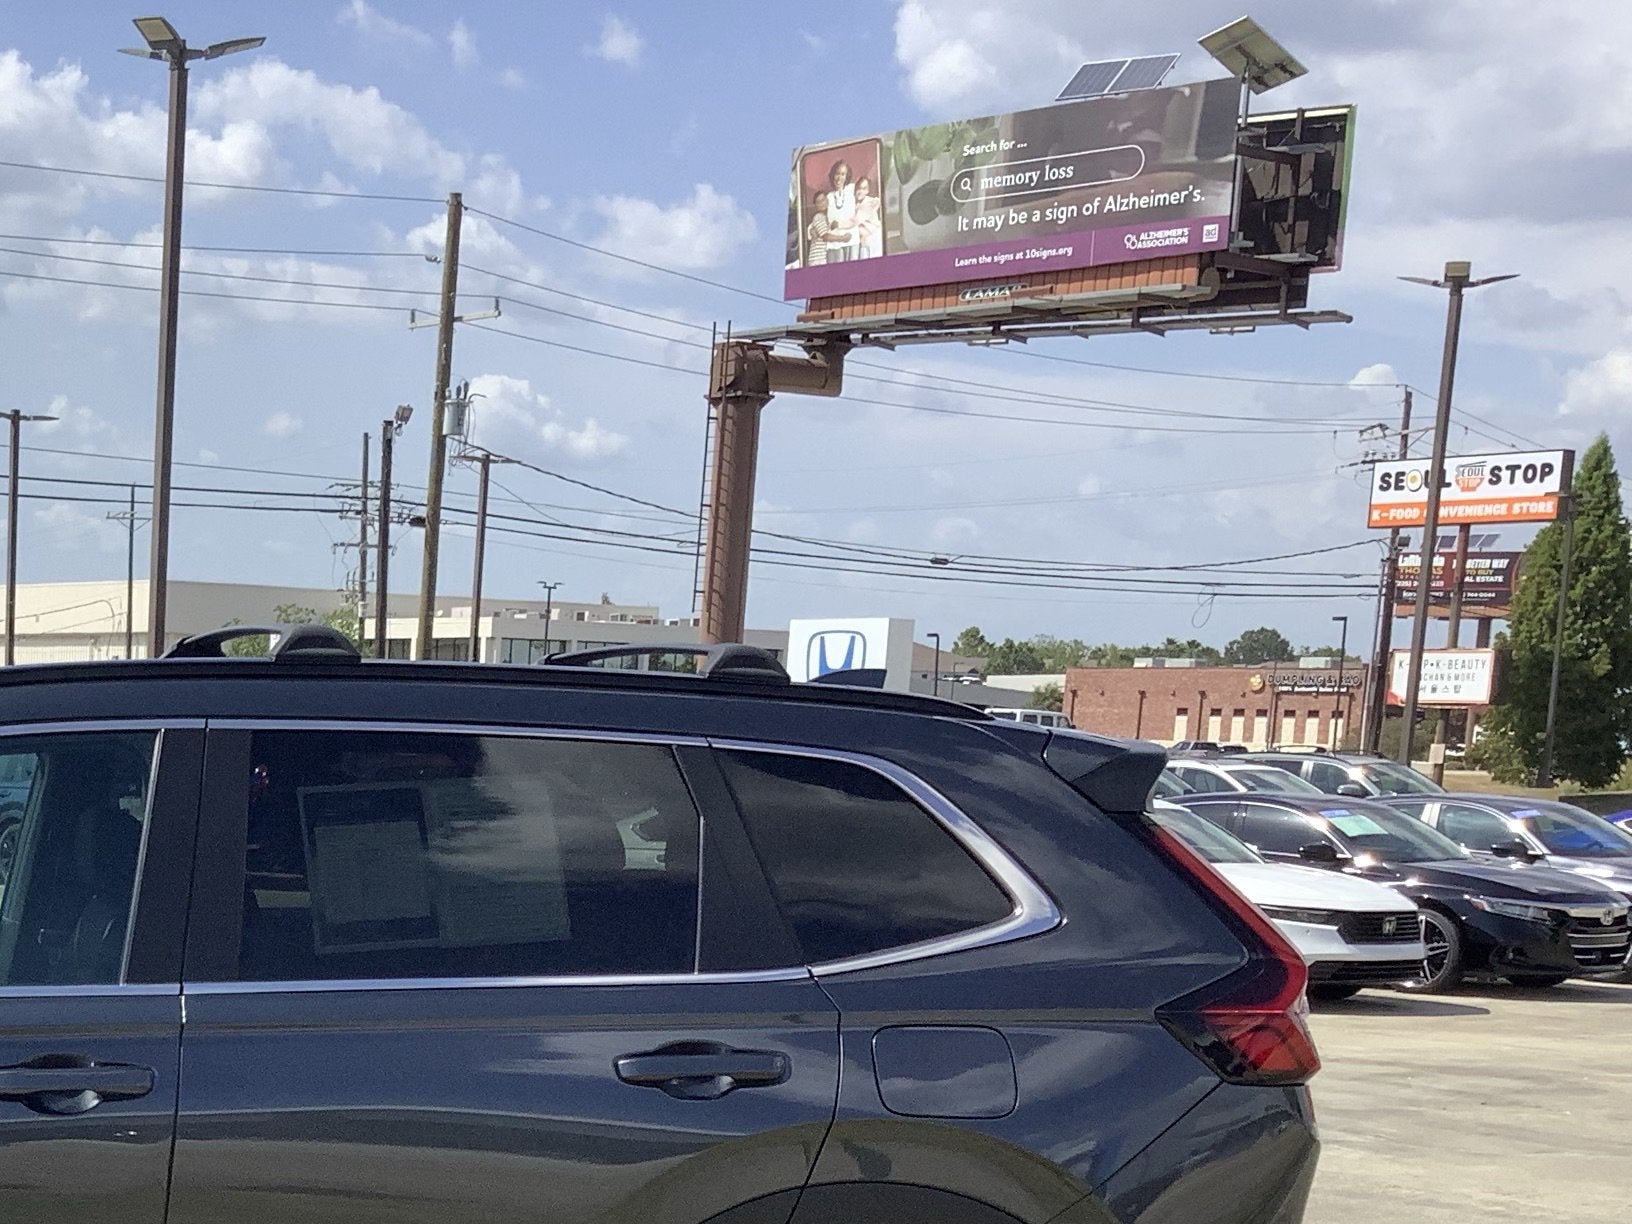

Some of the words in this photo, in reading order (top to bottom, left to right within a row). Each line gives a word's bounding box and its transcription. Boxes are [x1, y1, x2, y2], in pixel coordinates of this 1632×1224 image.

[963, 139, 998, 157] Search
[999, 138, 1015, 151] for
[980, 169, 1040, 189] memory
[1044, 164, 1074, 182] loss
[957, 216, 969, 232] It
[972, 214, 1005, 232] may
[1008, 209, 1028, 226] be
[1032, 209, 1041, 222] a
[1045, 201, 1078, 224] sign
[1082, 197, 1101, 218] of
[1136, 236, 1188, 249] ASSOCIATION
[954, 257, 978, 267] Learn
[978, 254, 992, 264] the
[993, 252, 1014, 265] signs
[1015, 251, 1024, 259] at
[1025, 246, 1073, 260] 10signs.org
[1488, 462, 1555, 486] STOP
[1371, 507, 1421, 521] K-FOOD
[1424, 502, 1508, 518] NVENIENCE
[1511, 500, 1554, 514] STORE
[1399, 566, 1444, 575] THOAS
[1267, 674, 1325, 686] DUMPLING
[1453, 672, 1476, 681] MORE
